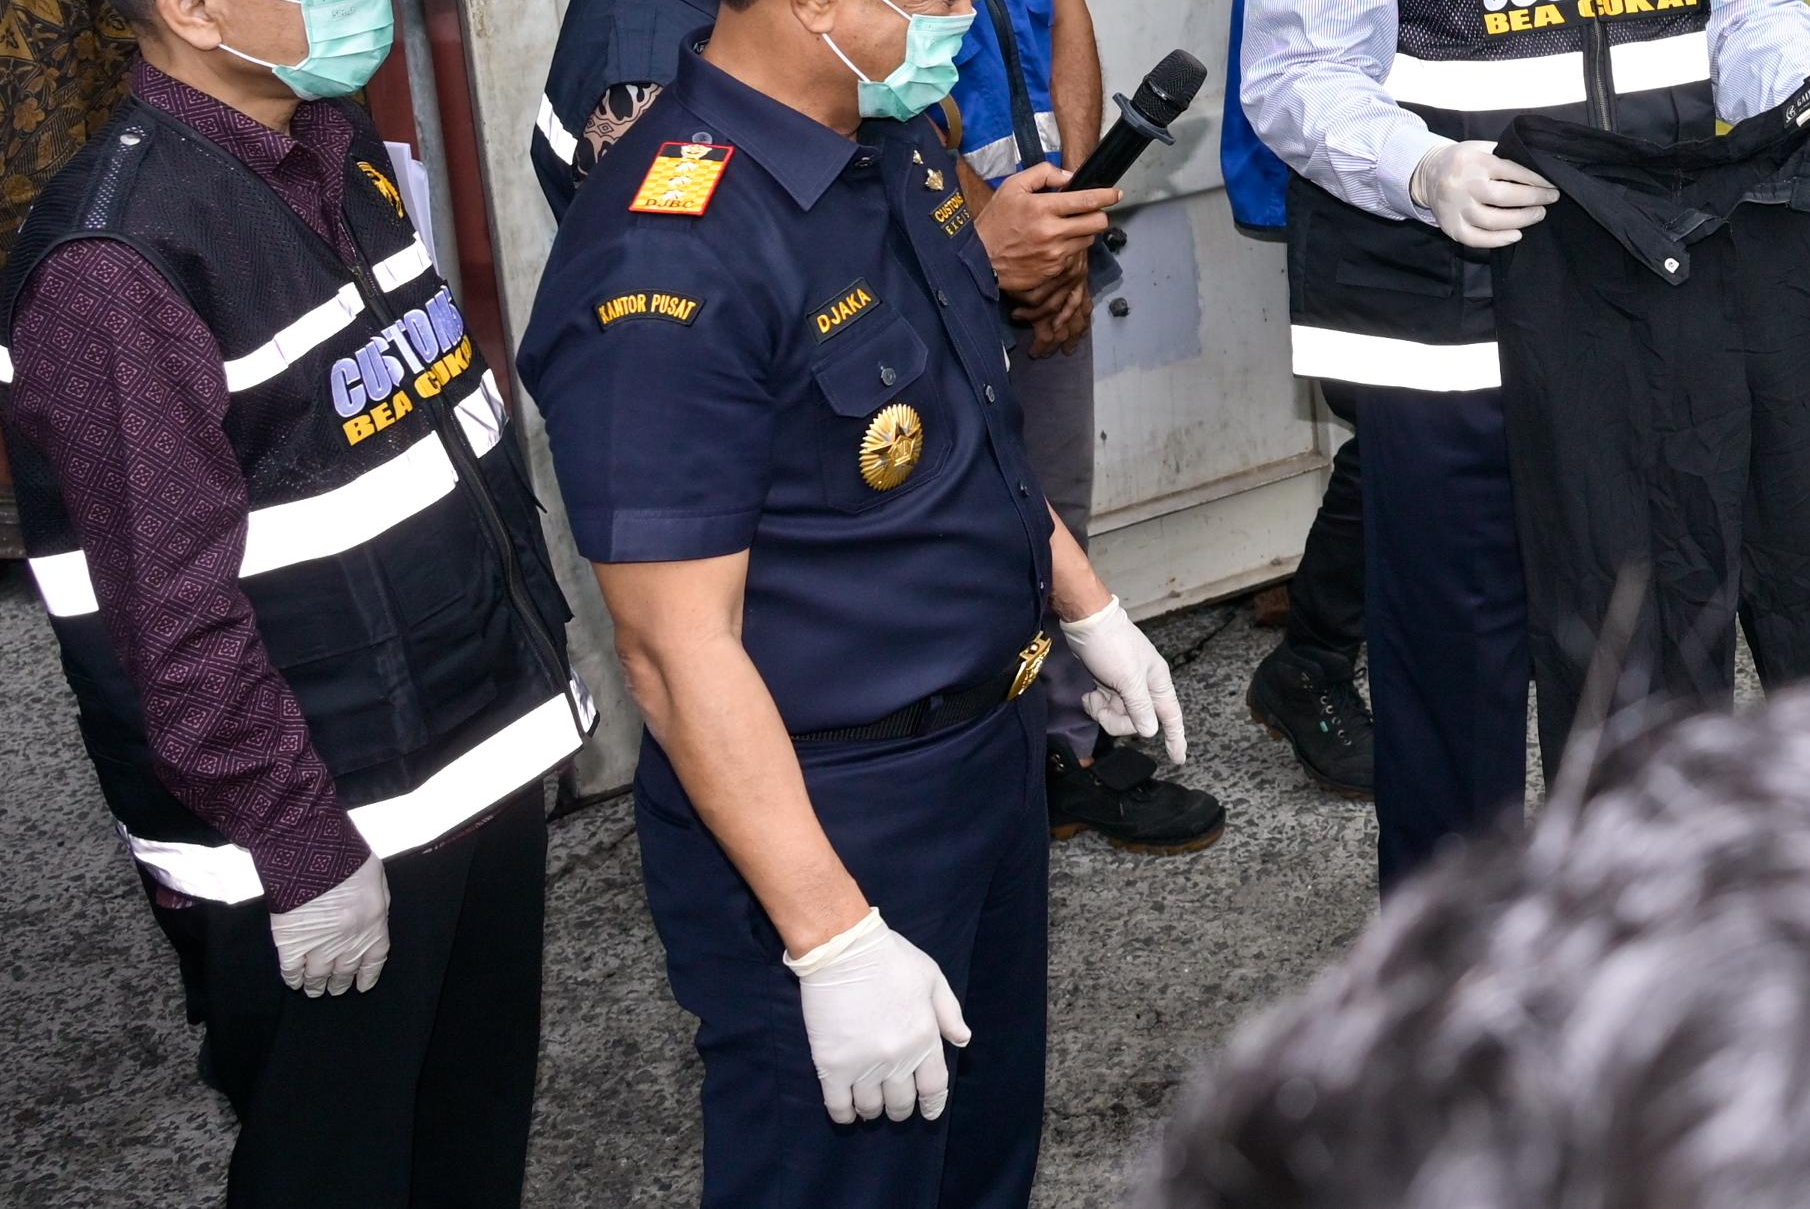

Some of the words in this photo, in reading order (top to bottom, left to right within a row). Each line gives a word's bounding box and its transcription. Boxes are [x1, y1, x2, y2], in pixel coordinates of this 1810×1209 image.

[1483, 4, 1565, 35] BEA
[645, 198, 695, 209] DJBC
[934, 192, 965, 223] CUSTOMS
[945, 209, 971, 235] EXCIS
[598, 293, 647, 324] KANTOR
[650, 294, 697, 321] PUSAT
[816, 288, 872, 334] DJAKA
[342, 390, 414, 446] BEA
[414, 334, 473, 399] CUKA
